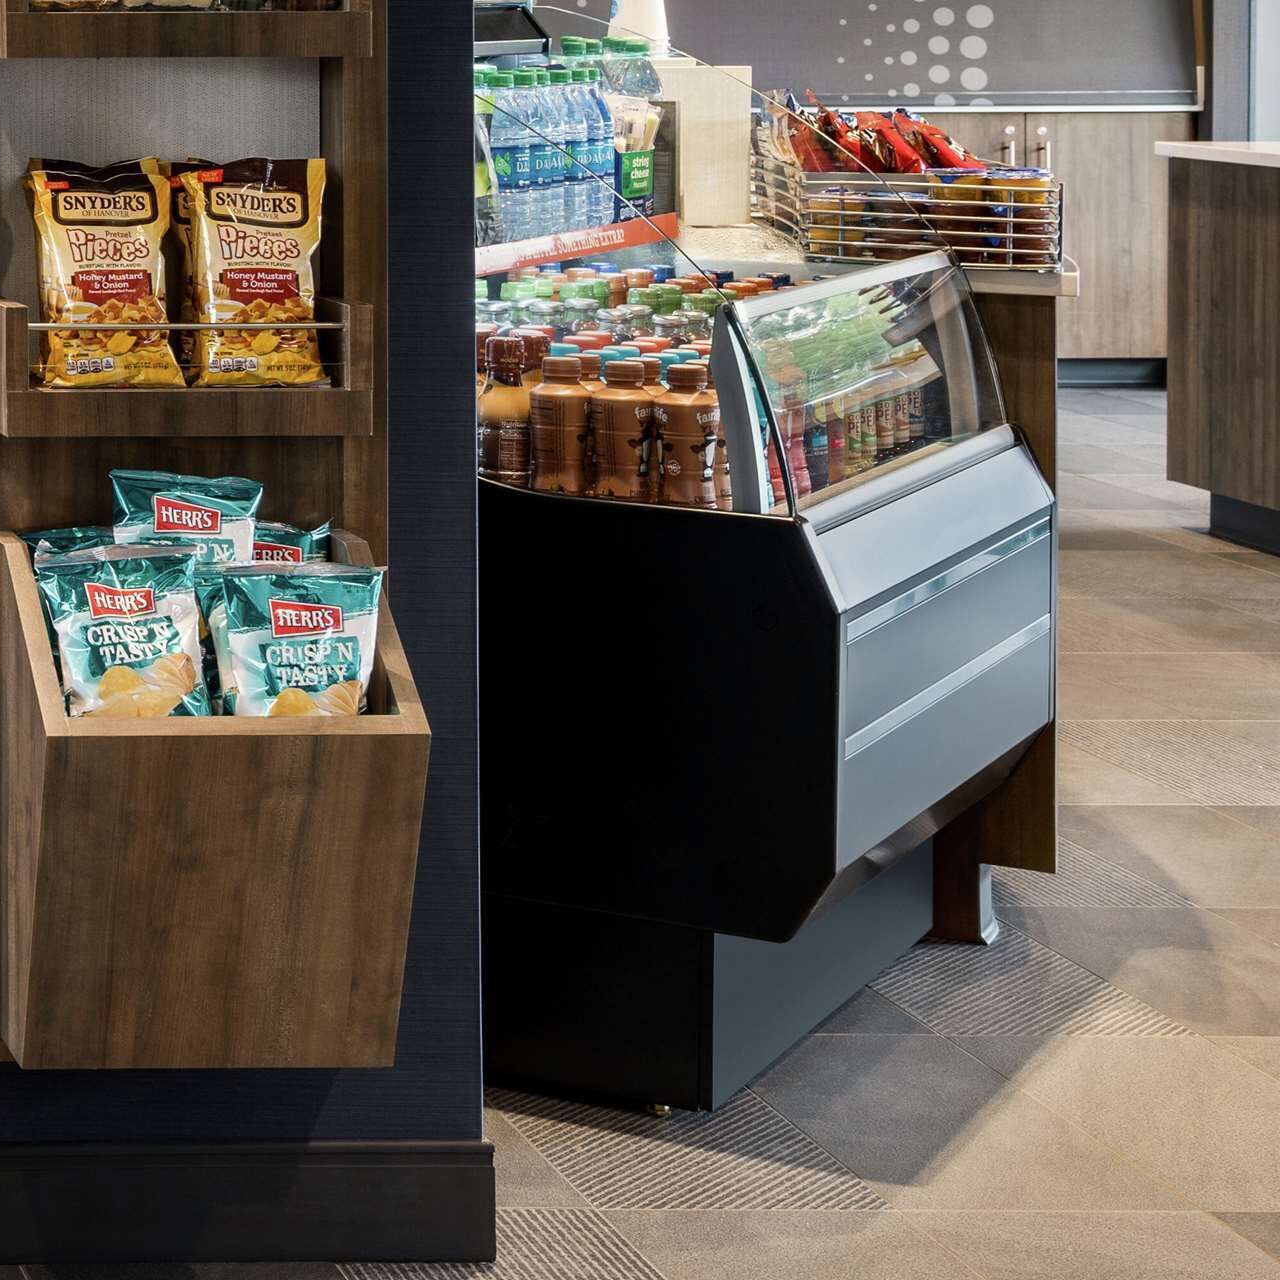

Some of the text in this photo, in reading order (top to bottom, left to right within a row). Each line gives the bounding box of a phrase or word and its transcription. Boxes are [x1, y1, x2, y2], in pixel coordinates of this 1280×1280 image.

[63, 195, 146, 212] SNYDER'S
[215, 191, 297, 214] SNYDER'S
[105, 230, 132, 238] Pretzel
[217, 223, 301, 261] Pieces
[599, 228, 625, 247] EXTRA?
[65, 228, 150, 262] Pieces
[79, 272, 144, 281] Honey Mustard
[94, 280, 129, 289] & Onion
[227, 271, 292, 280] Honey Mustard
[242, 280, 278, 288] & Onion
[160, 505, 213, 529] HERR'S
[94, 591, 147, 612] HERR'S
[276, 608, 334, 629] HERR'S
[87, 623, 148, 646] CRISP
[100, 640, 169, 666] TASTY
[265, 643, 332, 665] CRISP
[276, 664, 347, 687] TASTY
